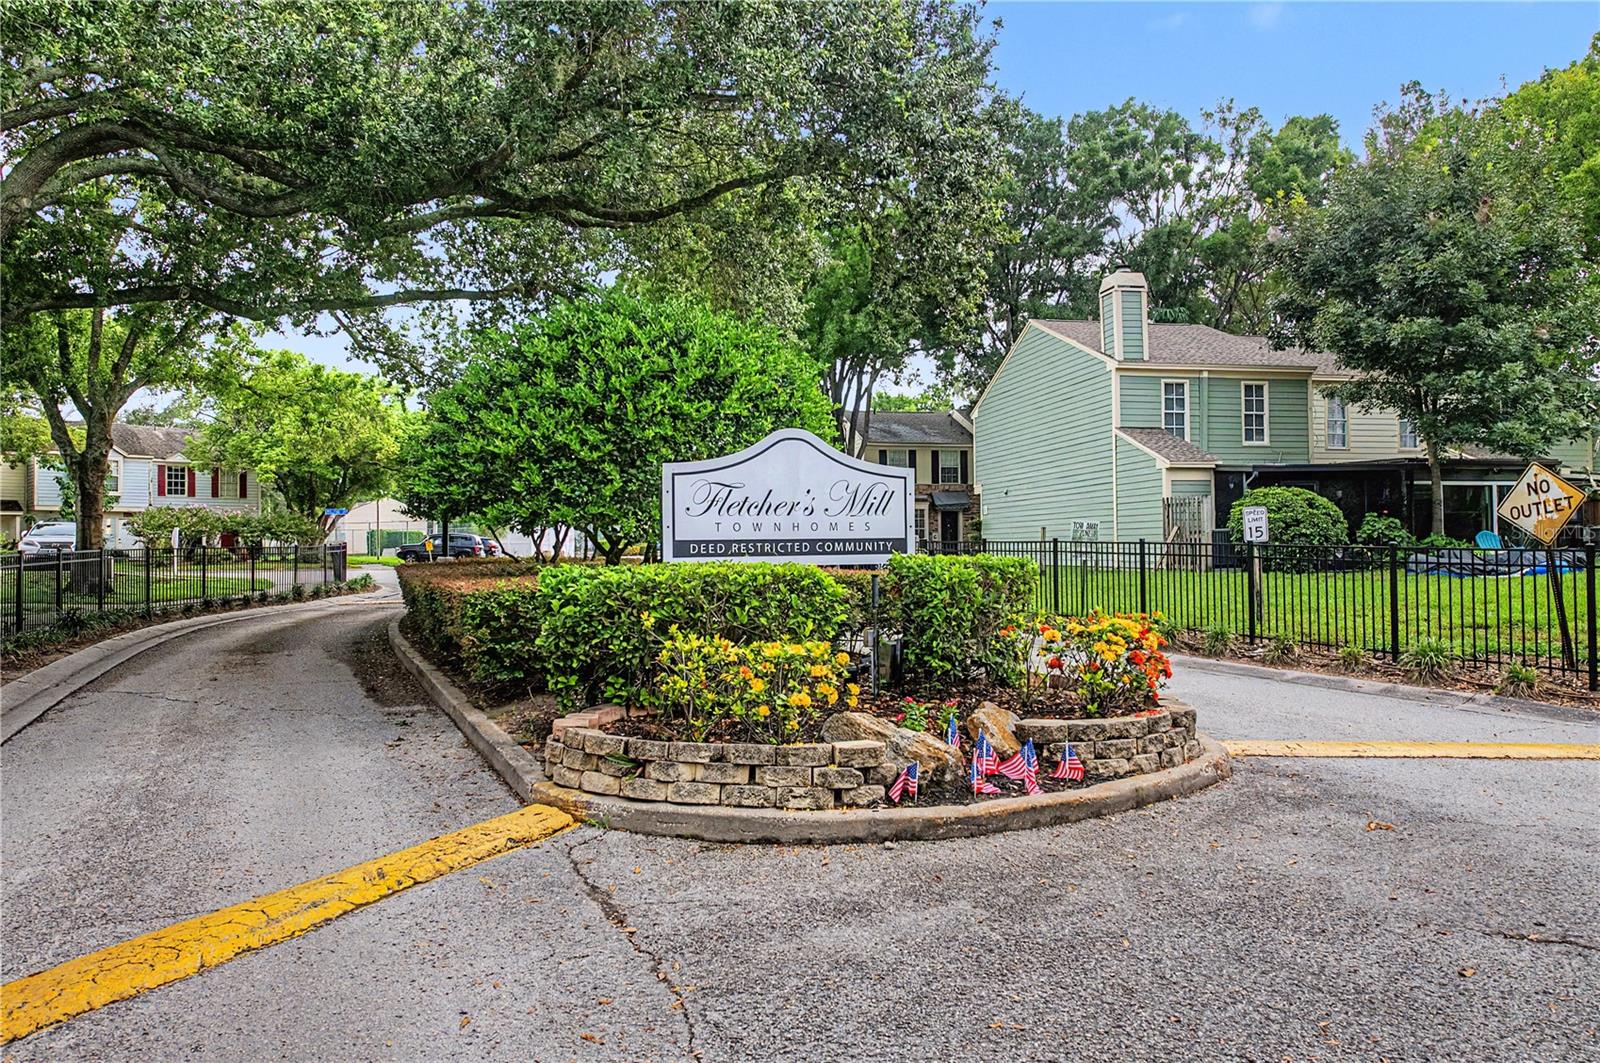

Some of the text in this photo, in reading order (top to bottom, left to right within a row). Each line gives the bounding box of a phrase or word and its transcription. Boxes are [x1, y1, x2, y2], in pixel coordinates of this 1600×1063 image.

[1526, 479, 1550, 496] NO
[685, 478, 895, 518] Fletcher's Mill
[1510, 496, 1574, 520] OUTLET
[715, 521, 872, 533] TOWNHOMES
[1248, 526, 1264, 539] 15
[690, 541, 893, 554] DEED RESTRICTED COMMUNITY
